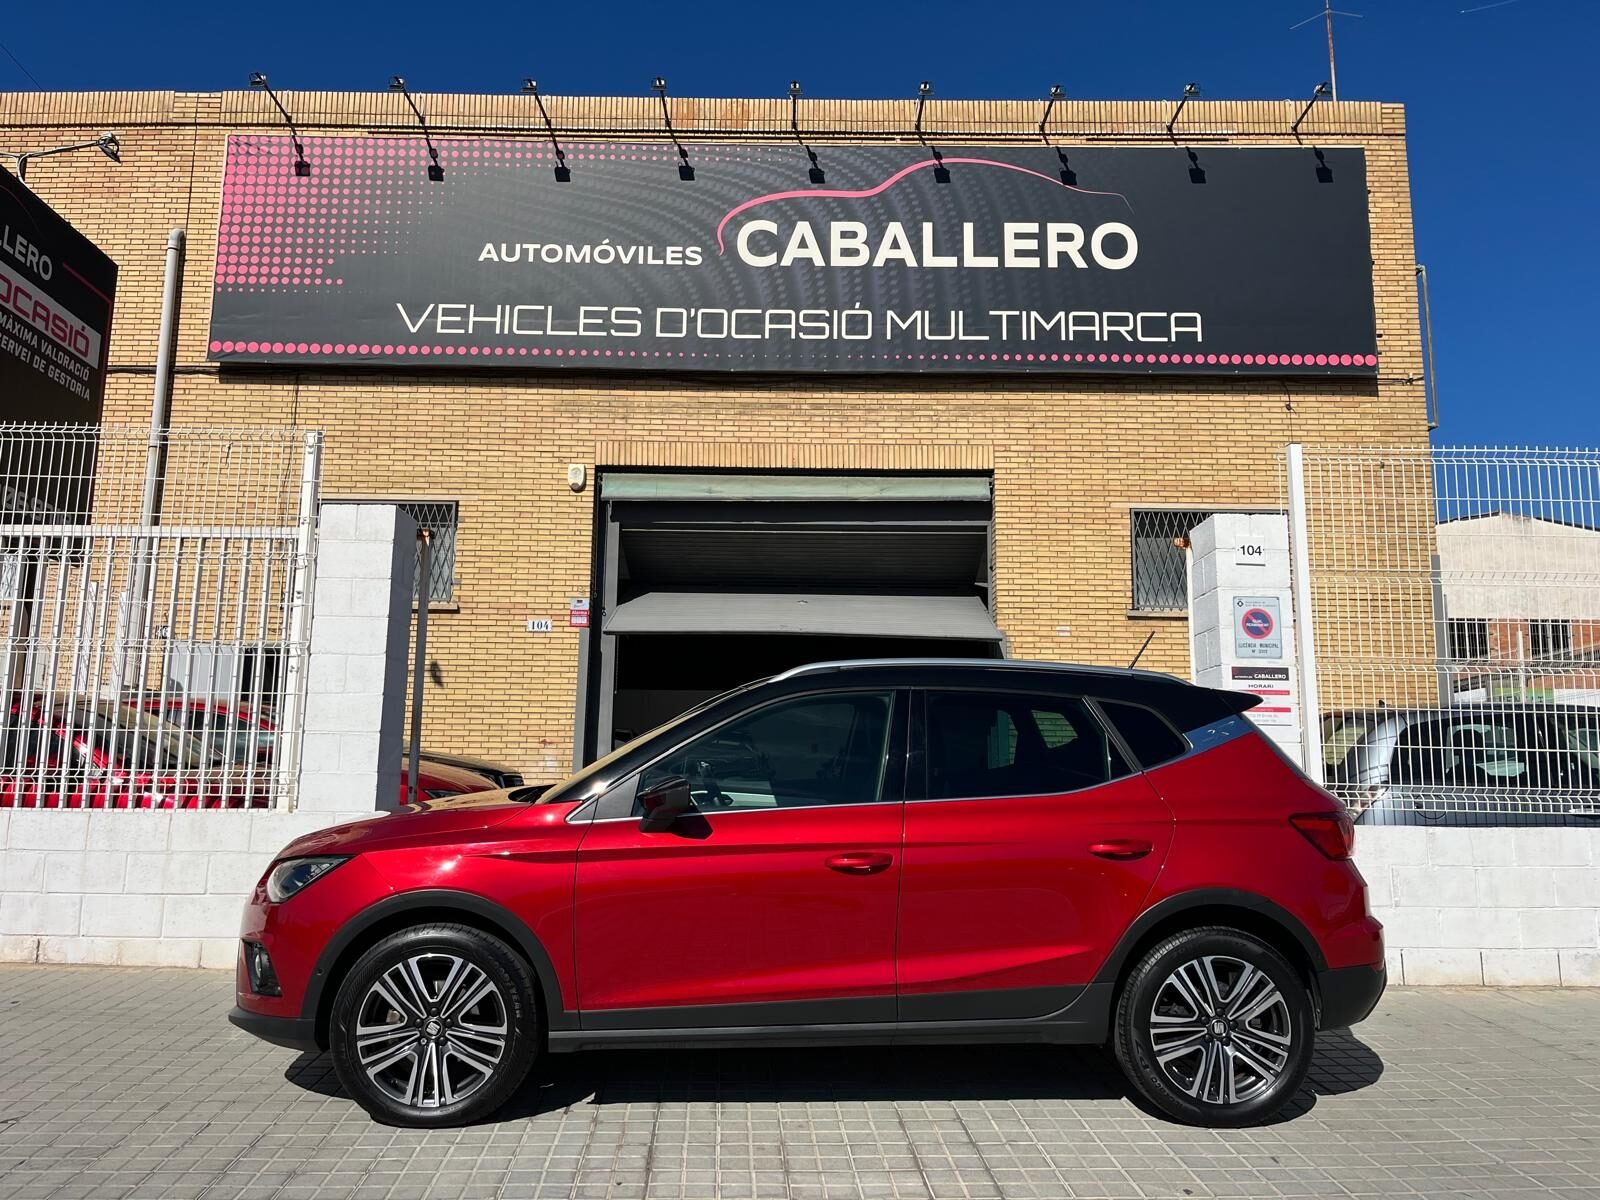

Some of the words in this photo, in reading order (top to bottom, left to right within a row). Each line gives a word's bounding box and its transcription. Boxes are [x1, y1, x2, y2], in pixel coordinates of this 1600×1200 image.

[0, 224, 53, 281] LERO
[477, 238, 703, 267] AUTOMÓVILES
[736, 219, 1139, 271] CABALLERO
[395, 303, 643, 338] VEHICLES
[655, 302, 873, 341] D'OCASIÓ
[886, 310, 1203, 343] MULTIMARCA
[0, 332, 31, 364] ERVEI
[32, 355, 47, 373] DE
[48, 365, 91, 401] GESTORIA
[41, 339, 90, 381] VALORACIÓ
[1240, 545, 1263, 556] 104
[531, 620, 549, 630] 104
